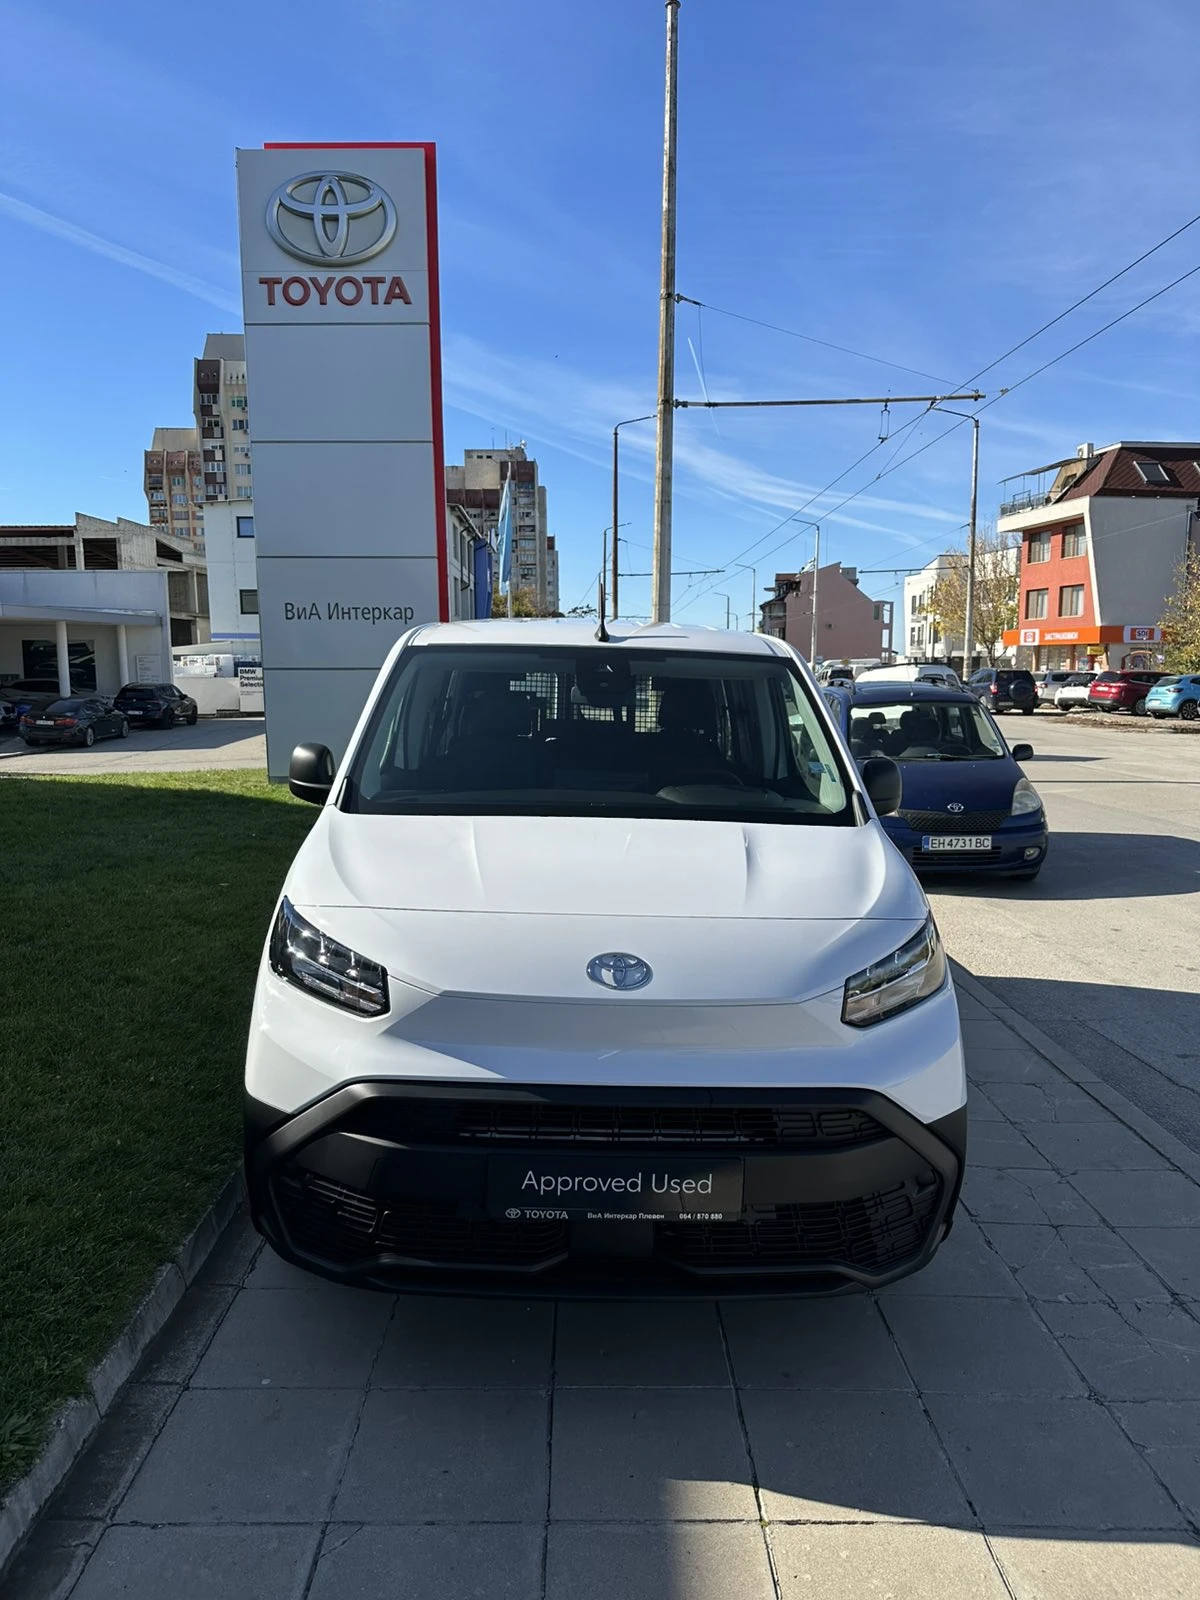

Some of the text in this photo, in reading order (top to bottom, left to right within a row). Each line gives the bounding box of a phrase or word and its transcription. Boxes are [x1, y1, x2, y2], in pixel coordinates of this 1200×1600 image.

[259, 276, 412, 306] TOYOTA
[284, 602, 414, 625] ВиА Интеркар
[930, 838, 946, 849] EH
[947, 838, 973, 848] 4731
[521, 1170, 713, 1195] Approved Used
[524, 1209, 569, 1219] TOYOTA
[604, 1212, 637, 1221] Интеркар
[679, 1212, 692, 1220] 064
